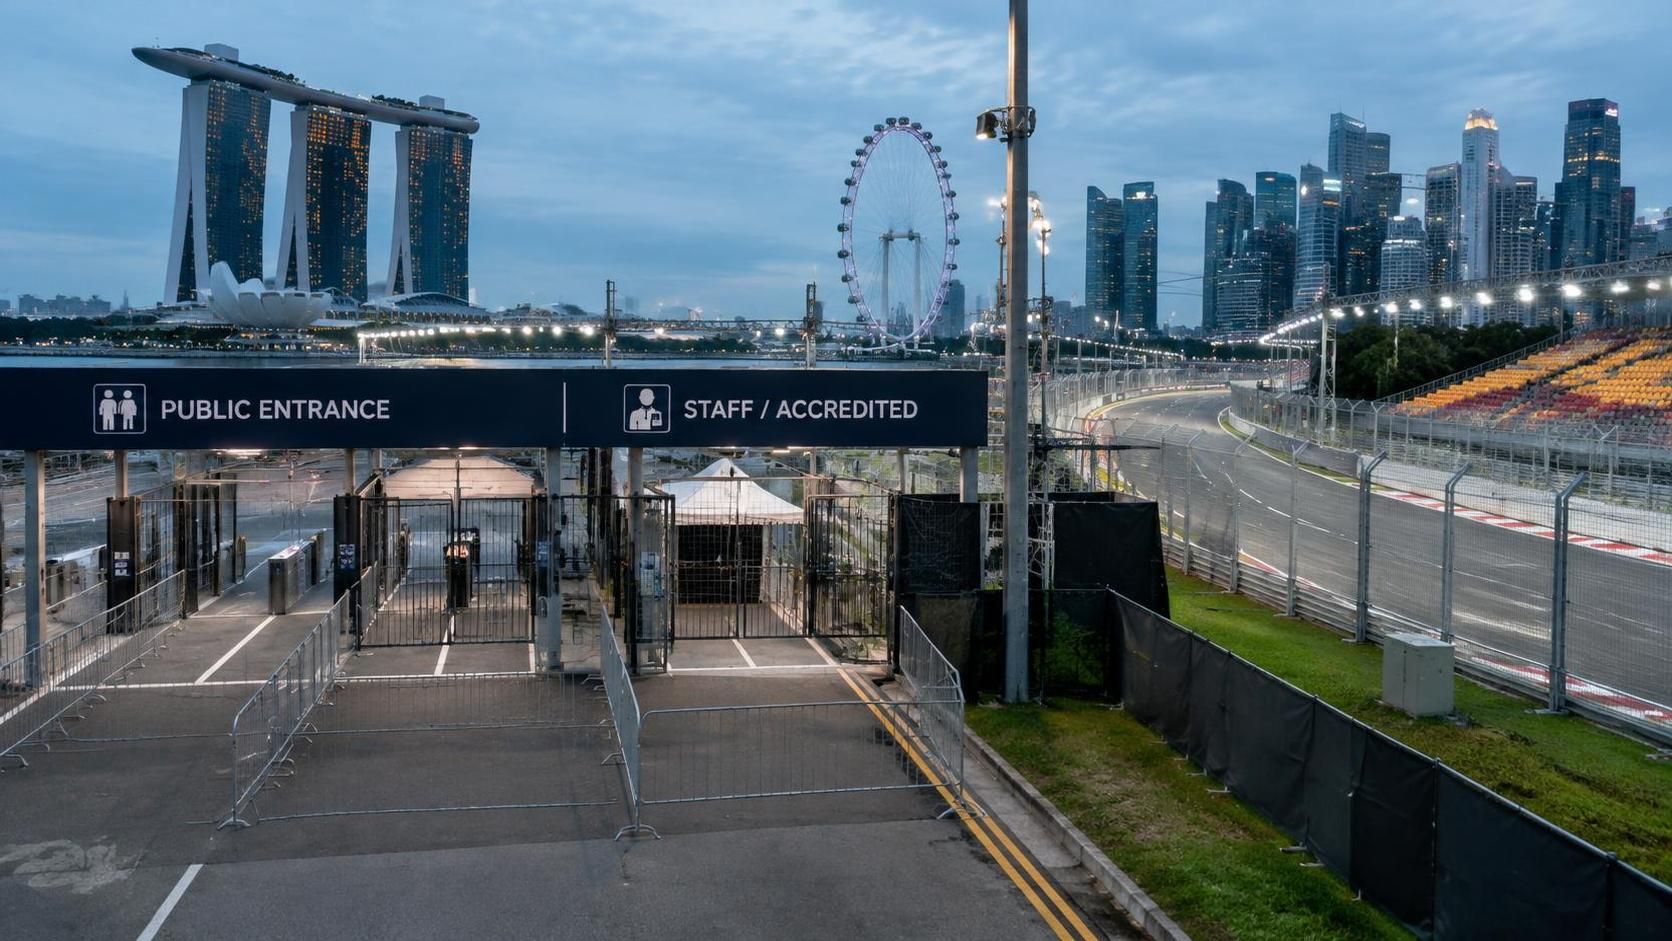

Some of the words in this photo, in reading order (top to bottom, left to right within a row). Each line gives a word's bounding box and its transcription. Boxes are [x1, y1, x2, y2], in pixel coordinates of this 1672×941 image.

[161, 399, 252, 419] PUBLIC
[259, 399, 390, 419] ENTRANCE
[684, 399, 754, 418] STAFF
[760, 399, 770, 419] /
[776, 399, 918, 418] ACCREDITED
